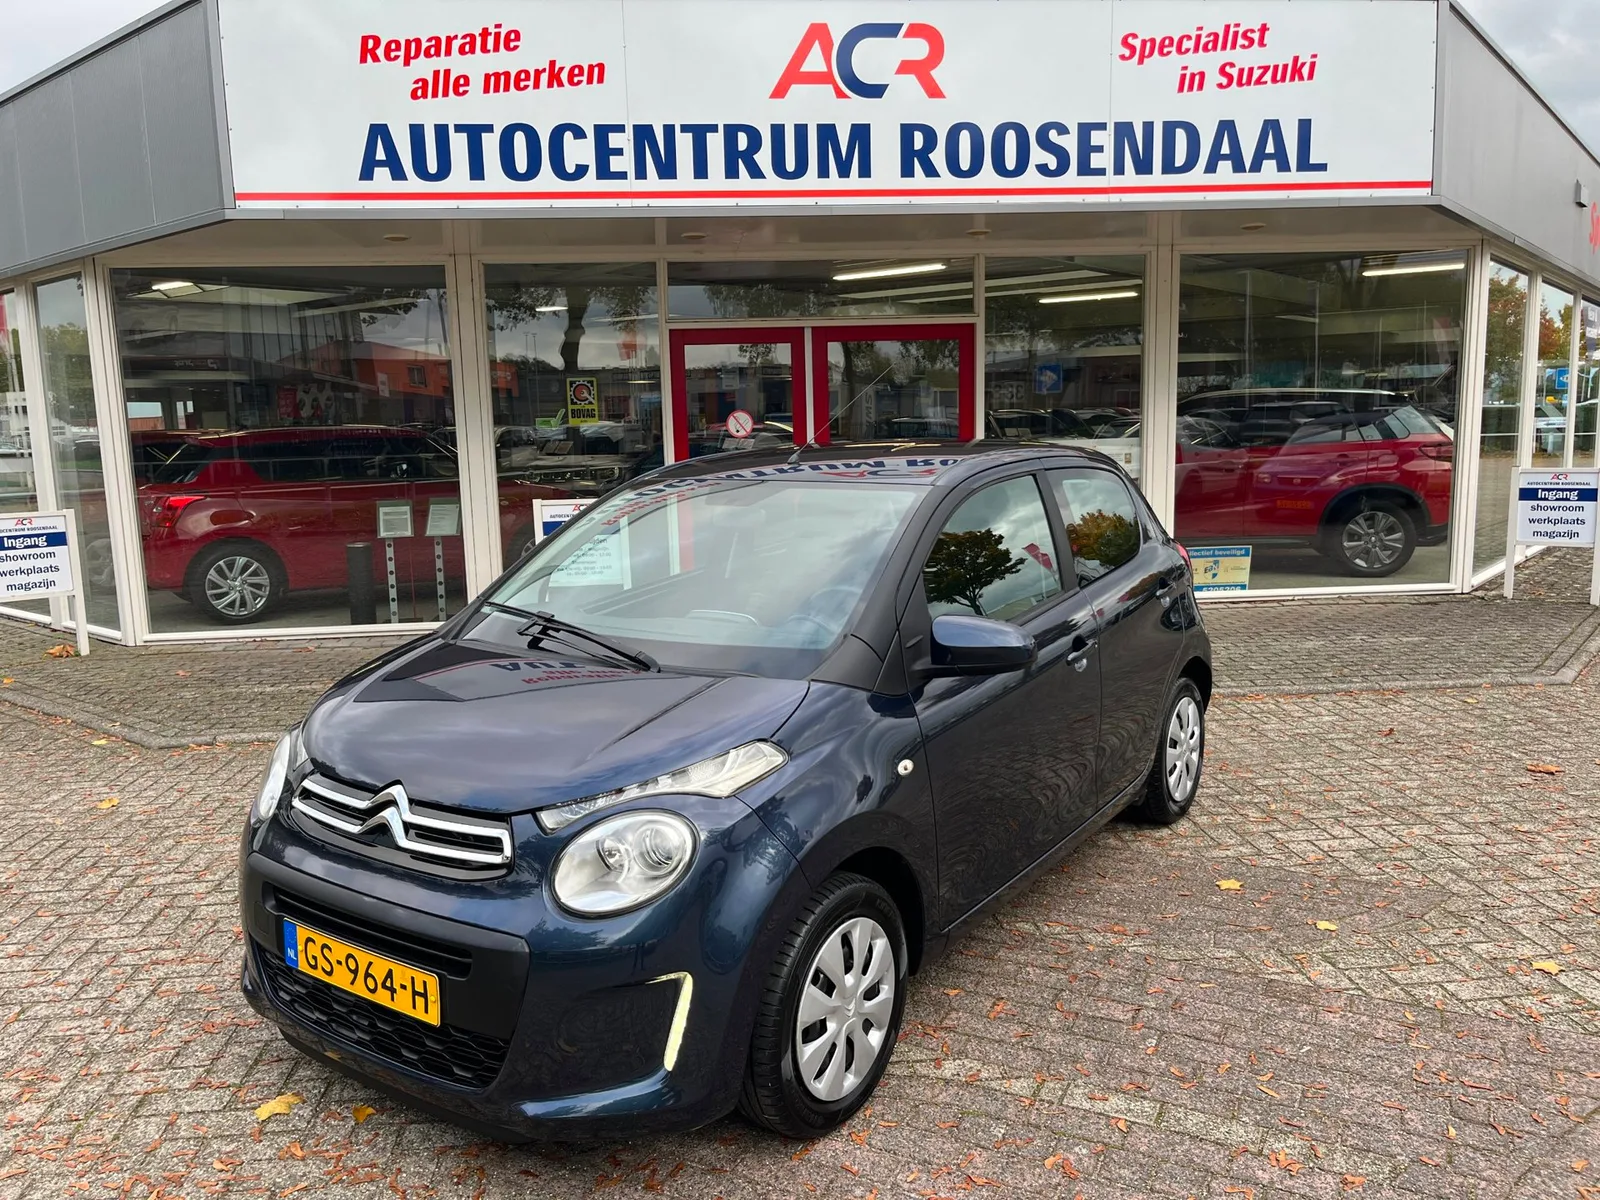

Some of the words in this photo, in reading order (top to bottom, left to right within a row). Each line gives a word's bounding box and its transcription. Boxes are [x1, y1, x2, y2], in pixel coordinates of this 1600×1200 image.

[360, 24, 522, 67] Reparatie
[1120, 22, 1269, 66] Specialist
[771, 23, 947, 100] ACR
[1178, 66, 1206, 94] in
[1216, 54, 1319, 91] Suzuki
[411, 68, 470, 102] alle
[483, 60, 606, 95] merken
[360, 123, 872, 183] AUTOCENTRUM
[900, 119, 1329, 179] ROOSENDAAL
[571, 408, 596, 419] BOVAG
[1538, 489, 1579, 500] Ingang
[1530, 504, 1585, 512] showroom
[1528, 517, 1586, 526] werkplaats
[1532, 530, 1580, 540] magazijn
[4, 535, 47, 549] Ingang
[0, 551, 56, 563] showroom
[0, 564, 60, 577] werkplaats
[6, 579, 56, 591] magazijn
[287, 947, 297, 960] NL
[304, 936, 429, 1015] GS-964-H
